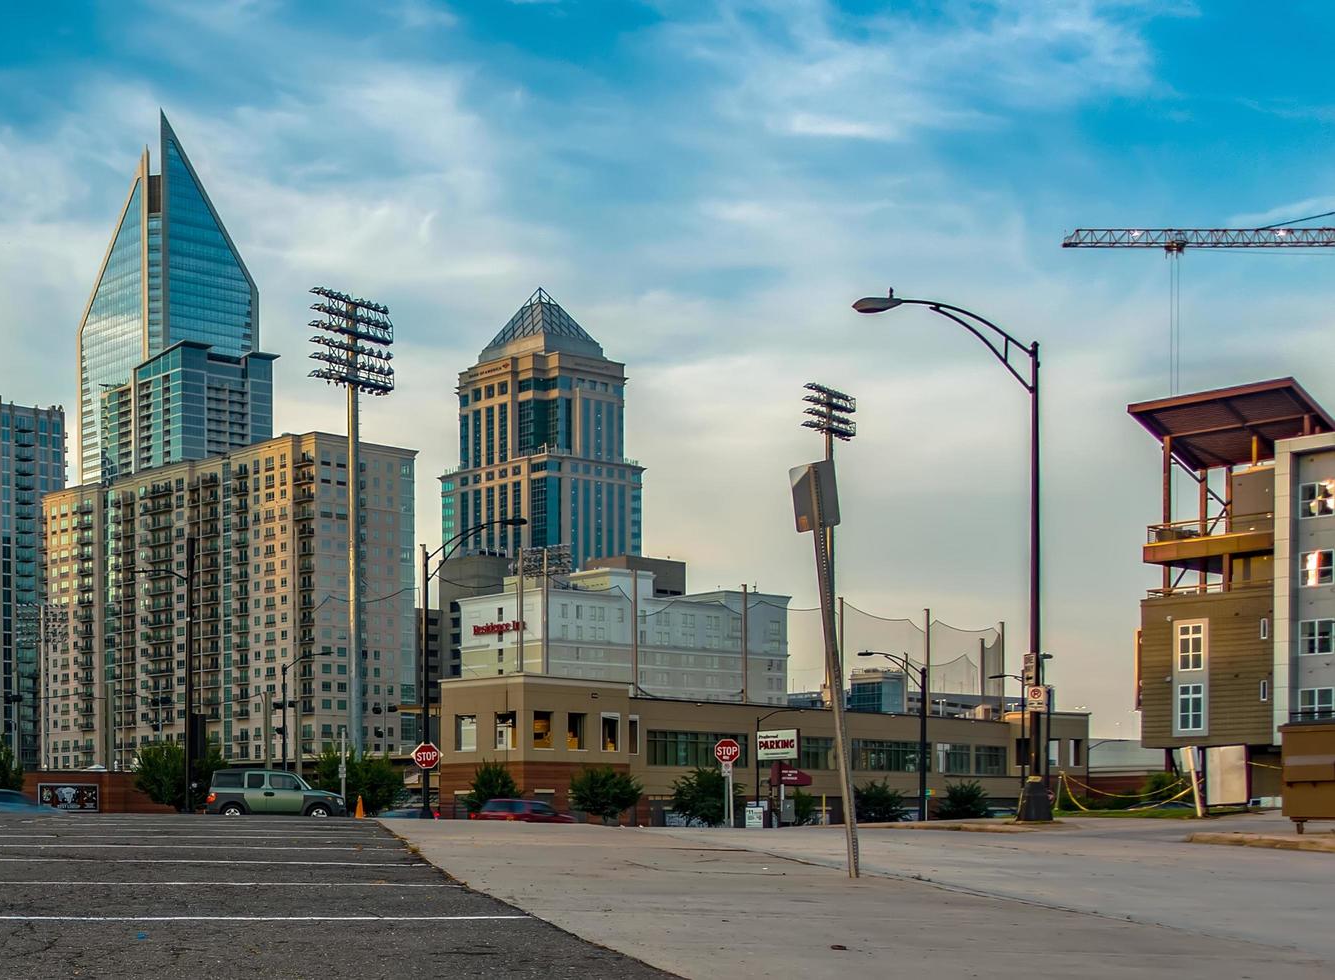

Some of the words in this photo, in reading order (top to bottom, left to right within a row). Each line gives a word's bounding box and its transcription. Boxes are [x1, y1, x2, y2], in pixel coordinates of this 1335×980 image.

[473, 622, 512, 635] Residence
[759, 739, 795, 750] PARKING
[416, 751, 437, 761] STOP
[716, 746, 738, 756] STOP
